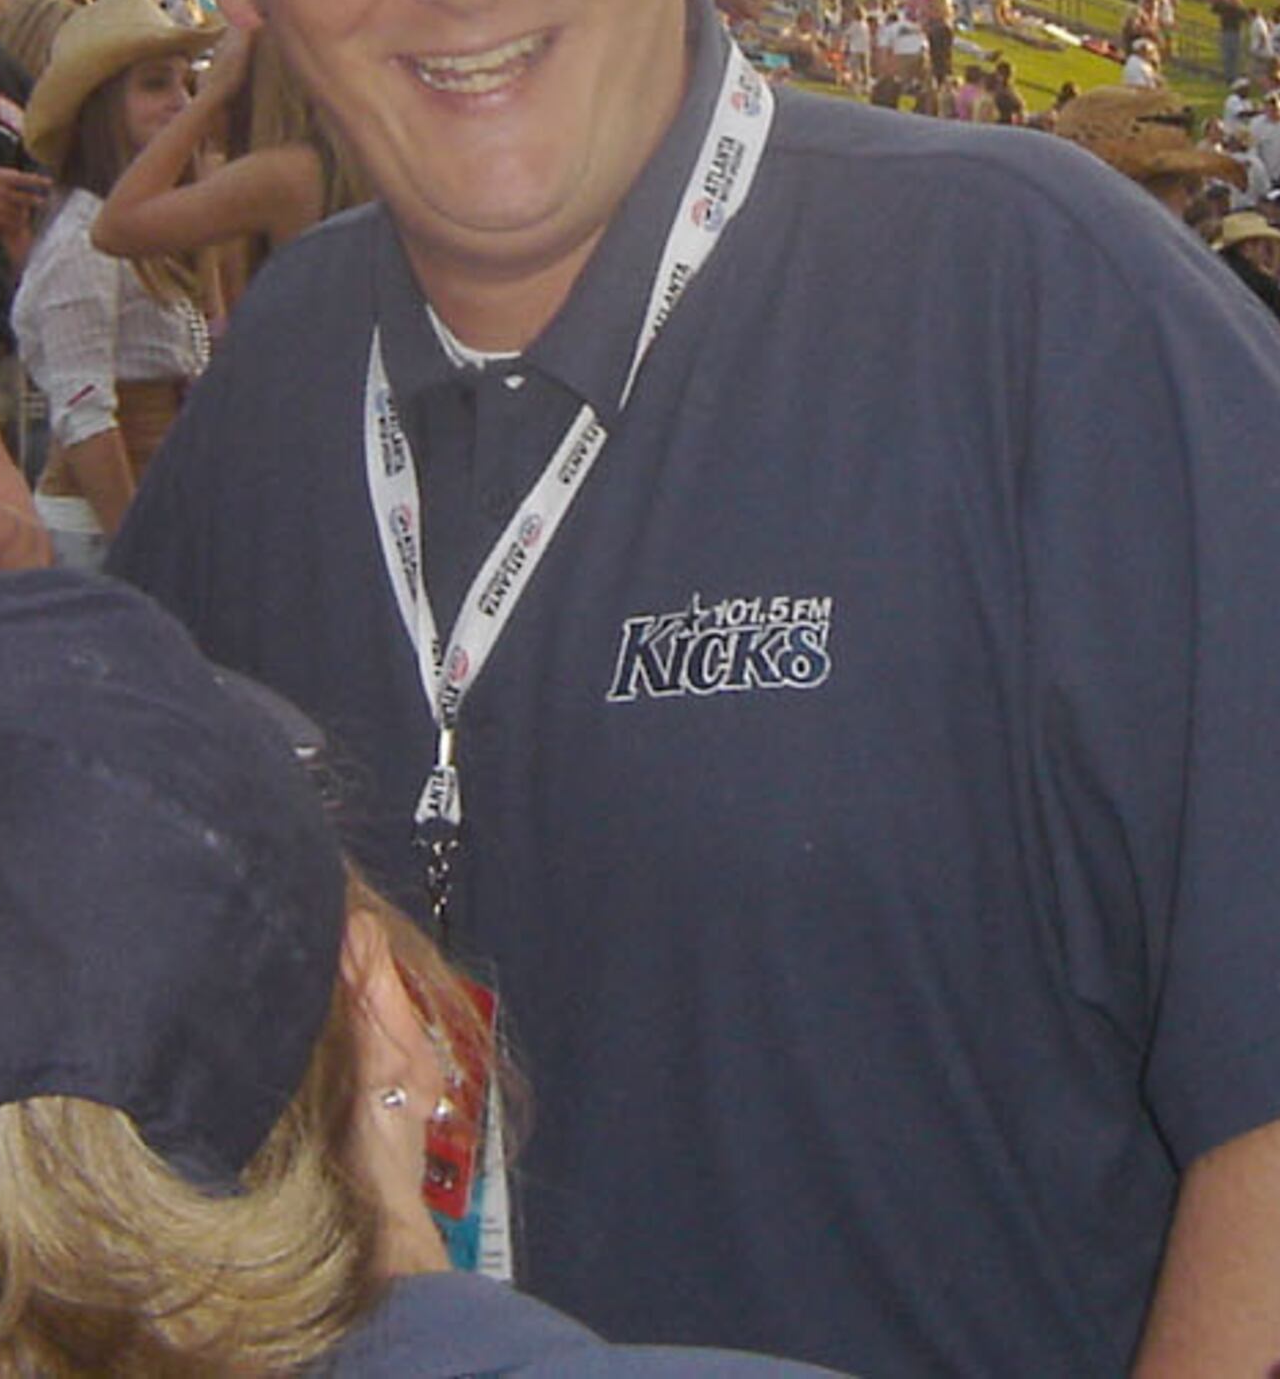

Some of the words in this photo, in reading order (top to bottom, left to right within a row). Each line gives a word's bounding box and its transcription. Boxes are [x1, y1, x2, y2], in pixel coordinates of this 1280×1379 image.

[482, 547, 528, 618] ATLANTA
[714, 596, 789, 625] 101.5
[793, 597, 832, 623] FM
